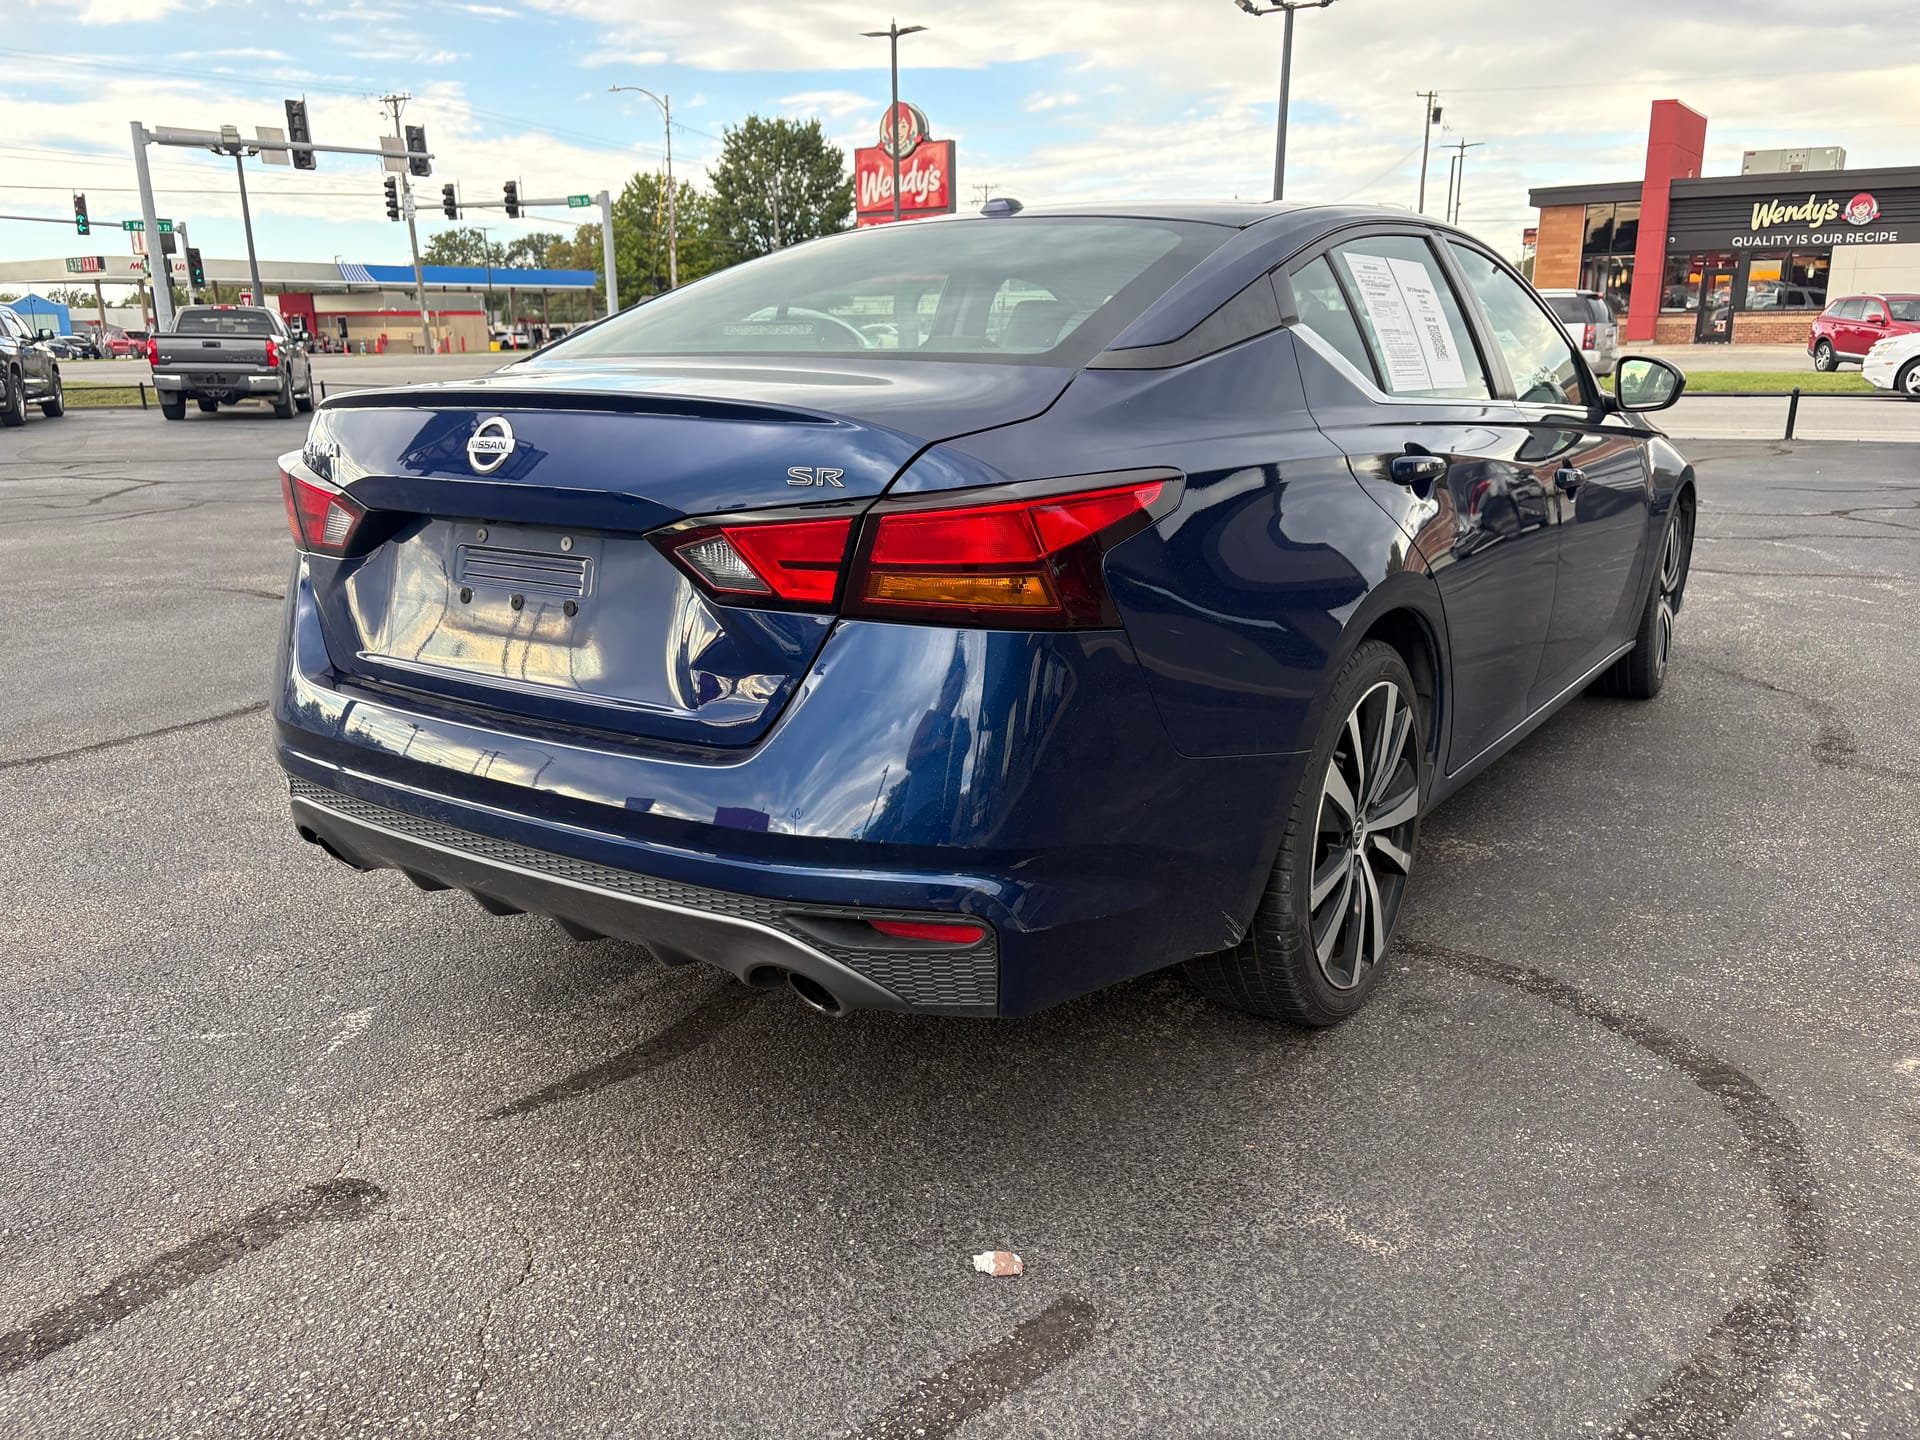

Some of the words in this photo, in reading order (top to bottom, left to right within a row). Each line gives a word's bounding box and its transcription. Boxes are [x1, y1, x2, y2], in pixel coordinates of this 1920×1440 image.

[861, 158, 941, 207] Wendy's
[1751, 194, 1840, 231] Wendy's
[1731, 235, 1794, 247] QUALITY
[1796, 234, 1808, 244] IS
[1811, 233, 1842, 244] OUR
[1846, 231, 1898, 243] RECIPE
[470, 440, 507, 450] NISSAN
[786, 466, 845, 487] SR
